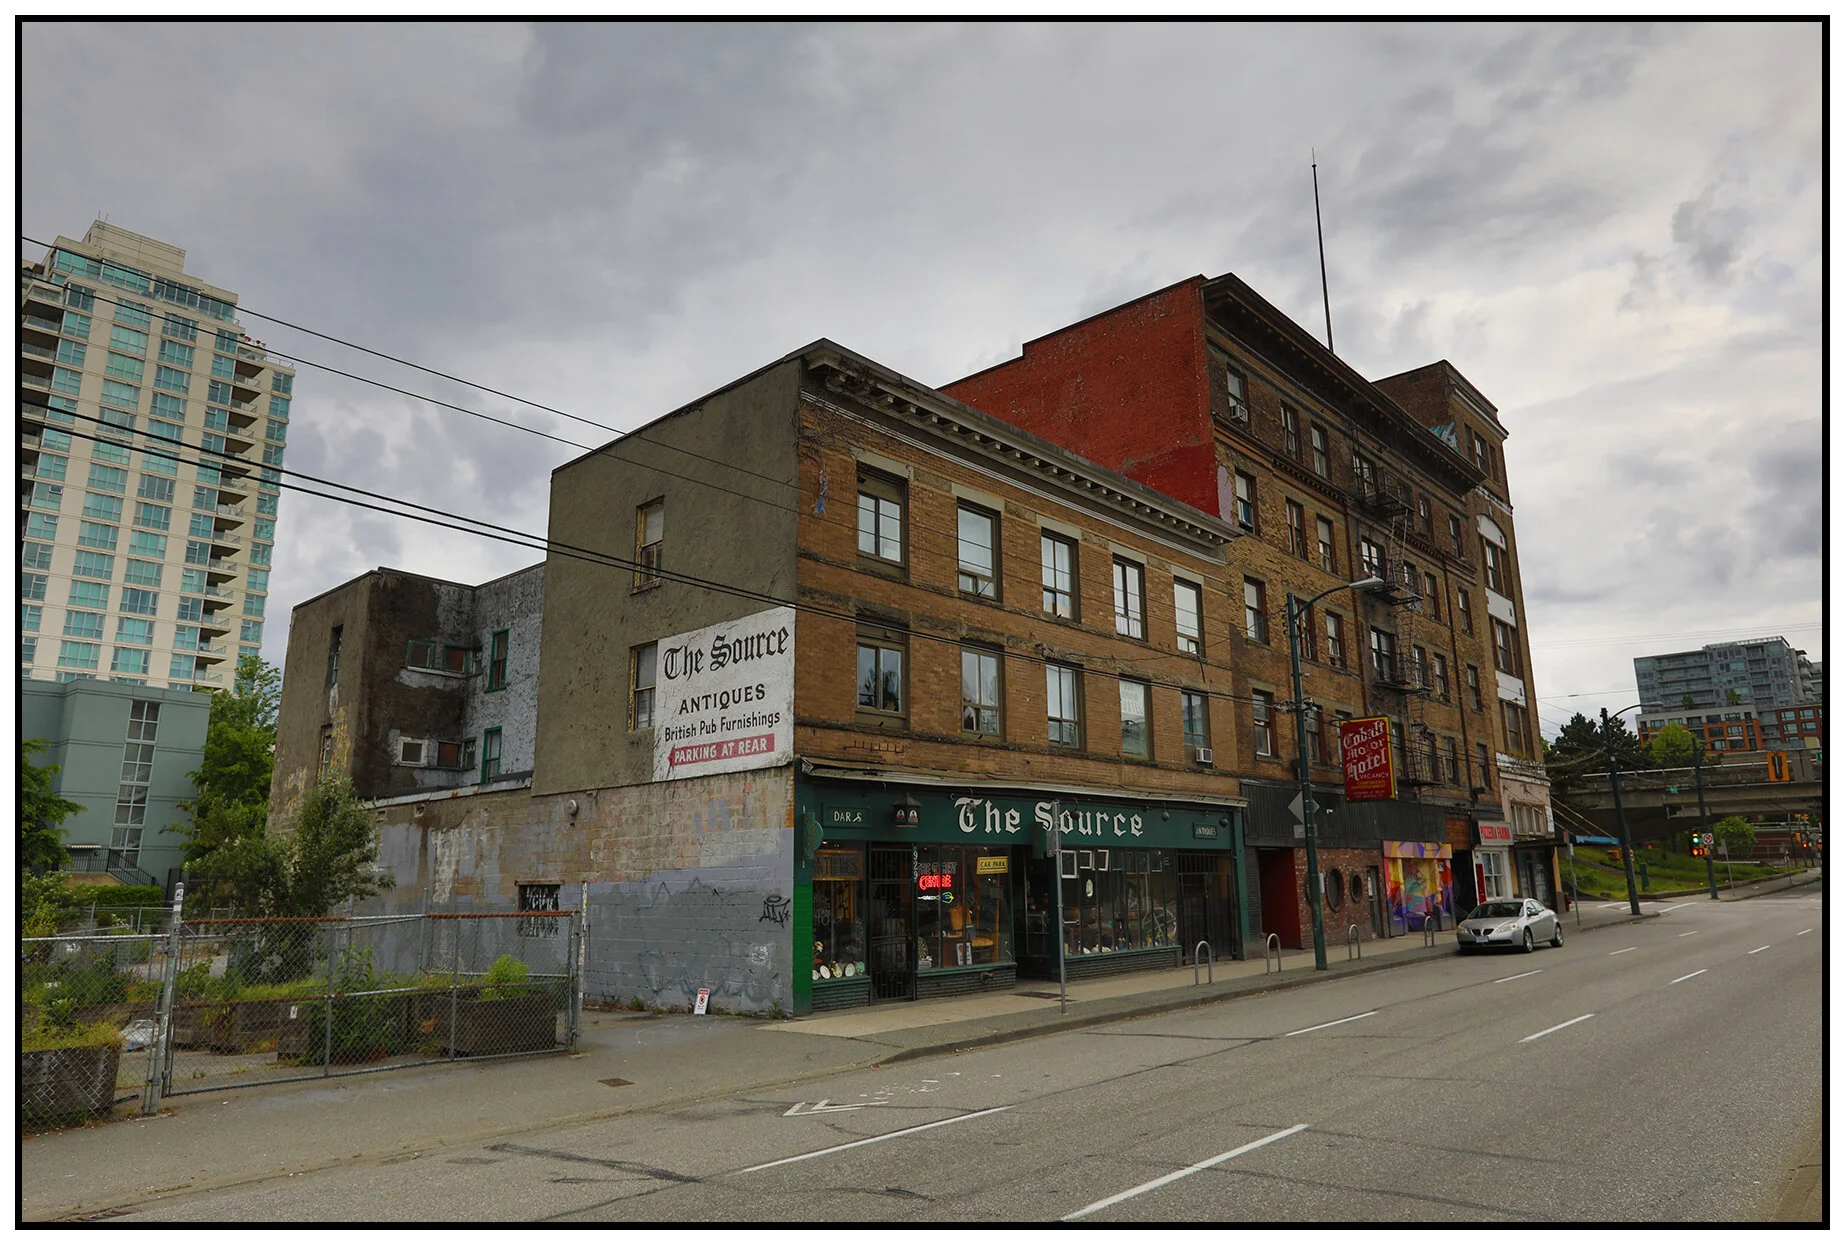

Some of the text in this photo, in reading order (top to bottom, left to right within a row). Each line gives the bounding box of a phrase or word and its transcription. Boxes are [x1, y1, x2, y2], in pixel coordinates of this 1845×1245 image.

[663, 626, 790, 681] The Source
[678, 683, 766, 715] ANTIQUES
[664, 710, 781, 742] British Pub Furnishings
[1343, 720, 1385, 749] Cobalt
[674, 736, 768, 764] PARKING AT REAR
[1346, 747, 1387, 781] Hotel
[1359, 772, 1389, 780] VACANCY
[954, 796, 1144, 837] The Source
[992, 860, 1006, 868] PARK
